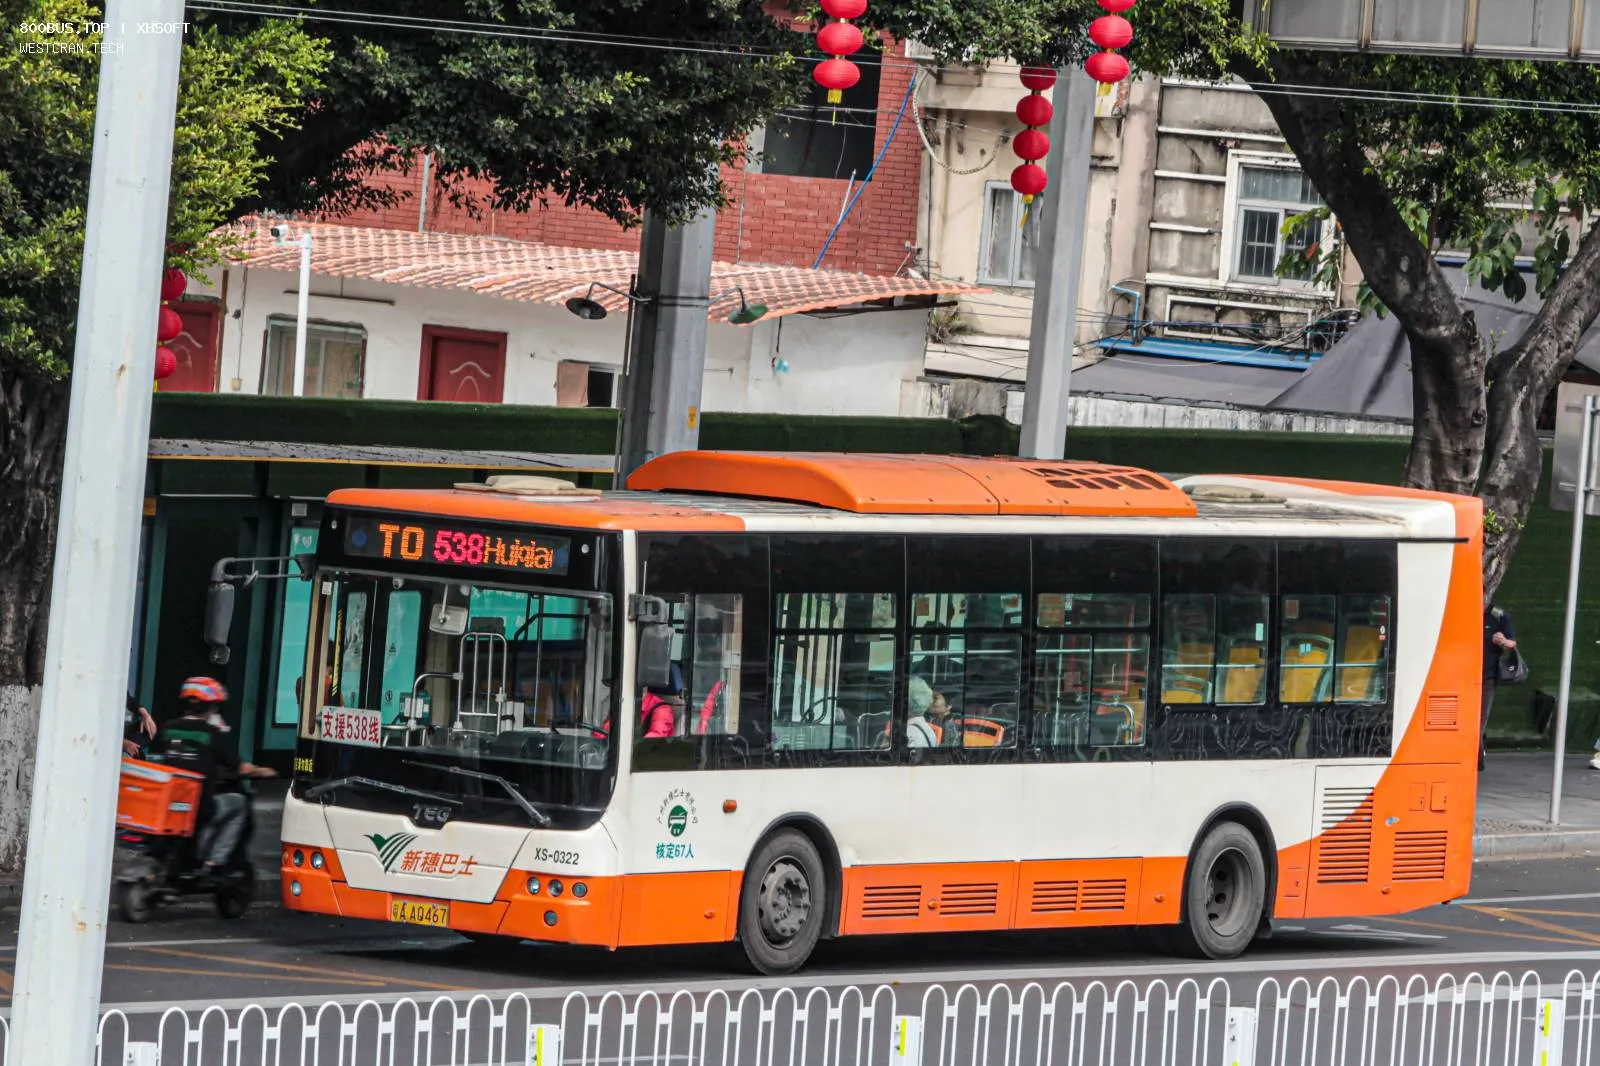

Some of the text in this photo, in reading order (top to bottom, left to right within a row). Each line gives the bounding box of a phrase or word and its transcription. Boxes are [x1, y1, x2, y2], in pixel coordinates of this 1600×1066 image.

[379, 522, 554, 569] TO 538 Huiqia
[322, 711, 379, 744] 支援538线
[411, 803, 452, 823] TEG
[534, 847, 580, 865] XS-0322
[655, 842, 695, 859] 核定67人
[400, 849, 478, 876] 新穗巴士
